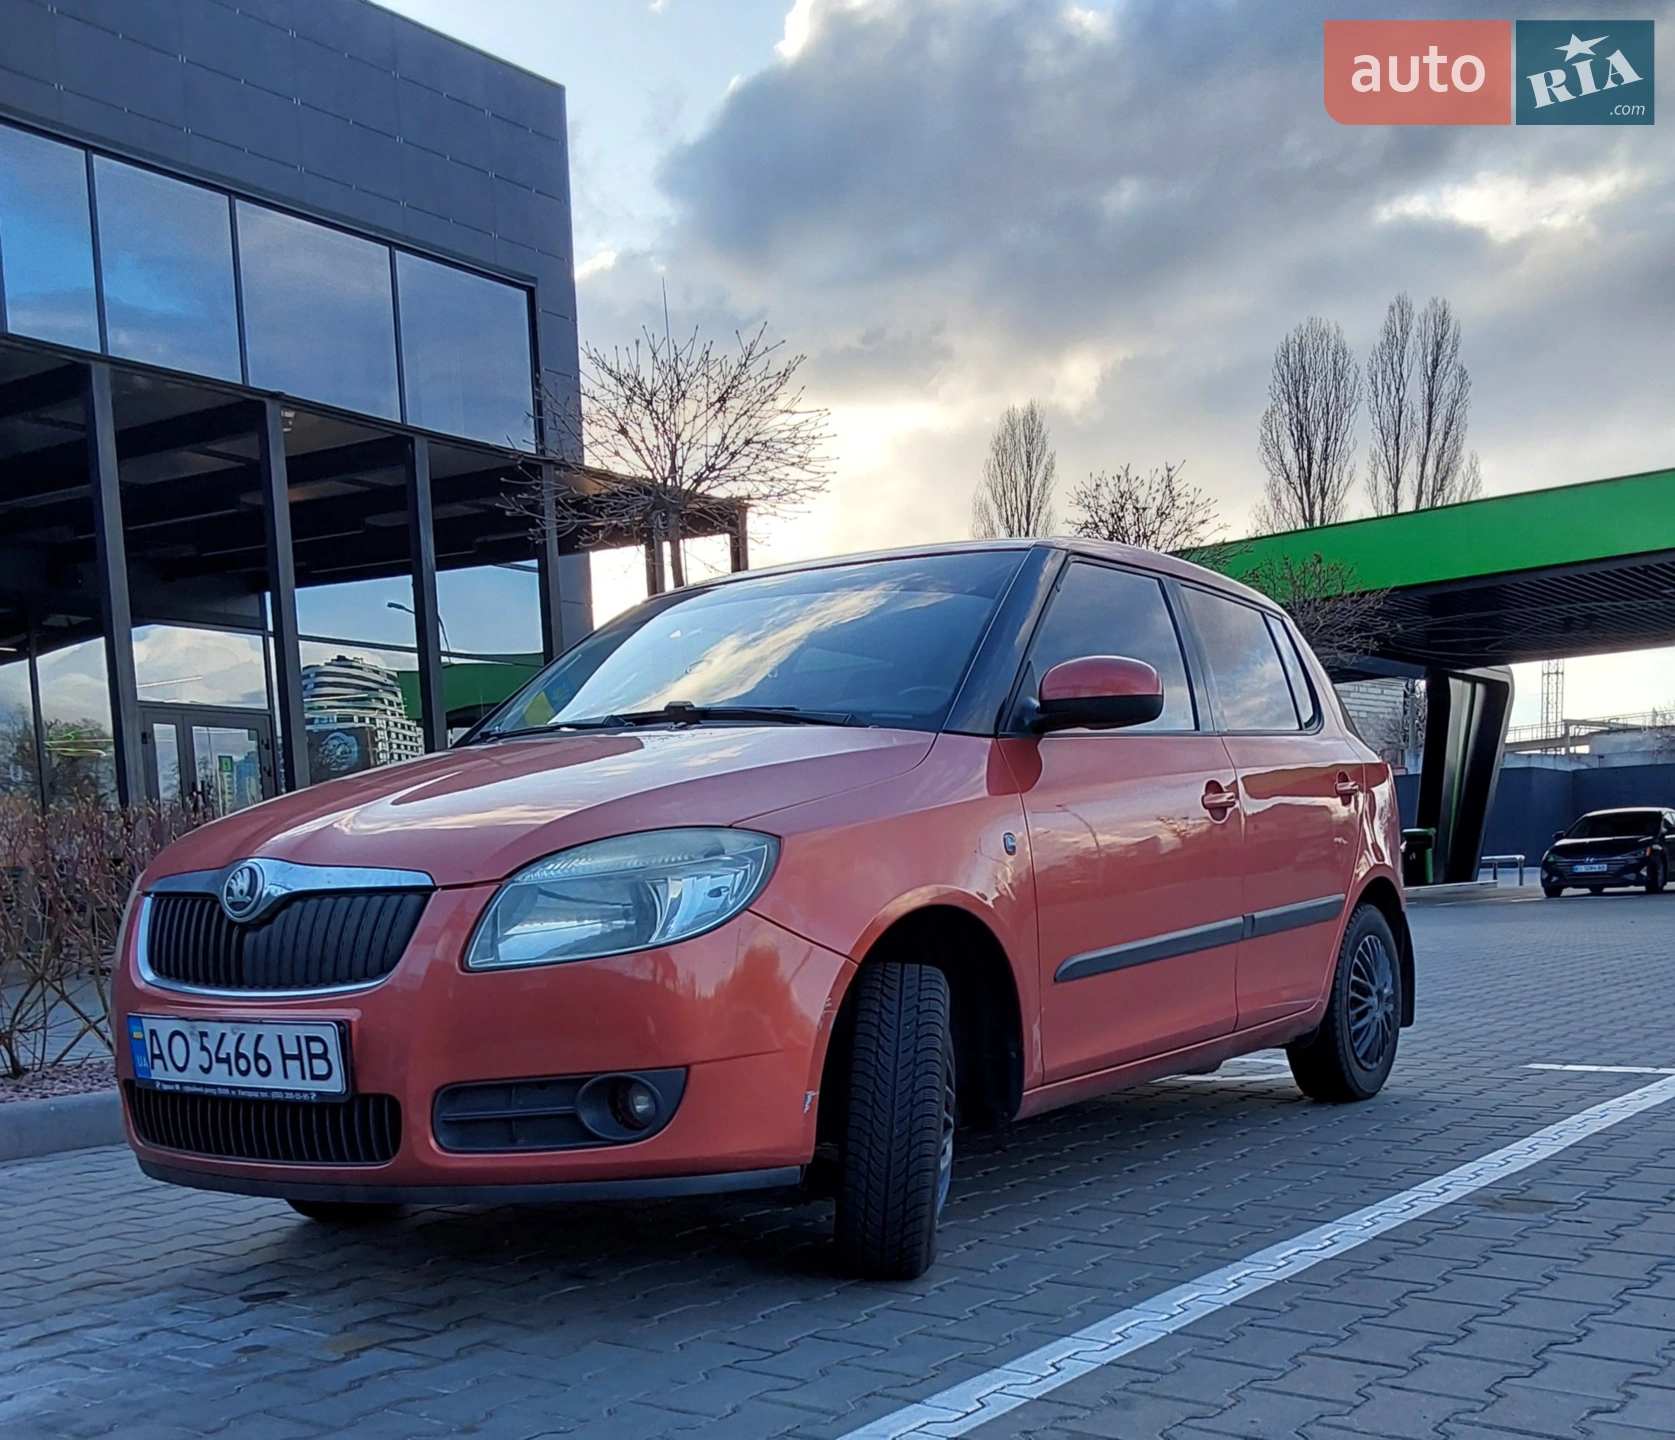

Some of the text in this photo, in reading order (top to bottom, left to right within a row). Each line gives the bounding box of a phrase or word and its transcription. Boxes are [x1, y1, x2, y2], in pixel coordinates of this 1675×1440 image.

[136, 1055, 149, 1069] UA
[149, 1028, 334, 1082] AO 5466 HB
